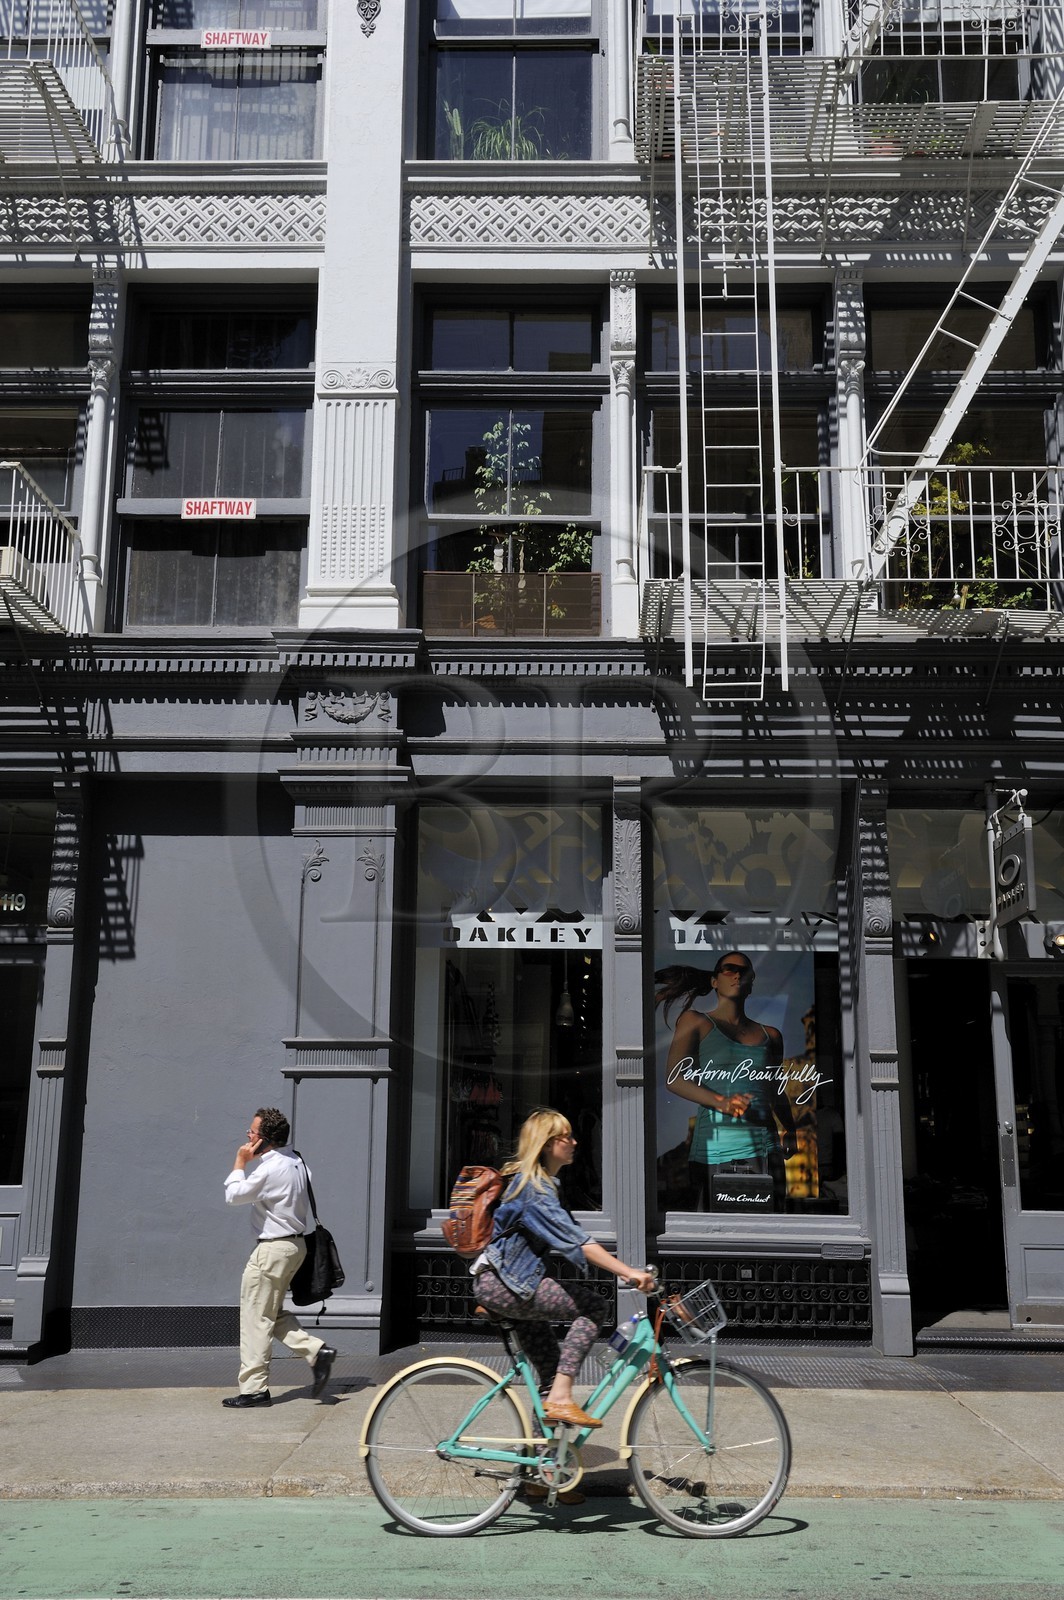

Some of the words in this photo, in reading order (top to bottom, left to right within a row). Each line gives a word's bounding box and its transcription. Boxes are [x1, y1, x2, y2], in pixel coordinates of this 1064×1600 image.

[205, 32, 268, 45] SHAFTWAY
[185, 501, 252, 515] SHAFTWAY
[1, 893, 26, 911] 119
[443, 927, 592, 942] OAKLEY
[667, 1056, 731, 1087] Perform
[730, 1058, 834, 1105] Beautifully
[716, 1193, 736, 1202] Miss
[736, 1193, 771, 1203] Conduct
